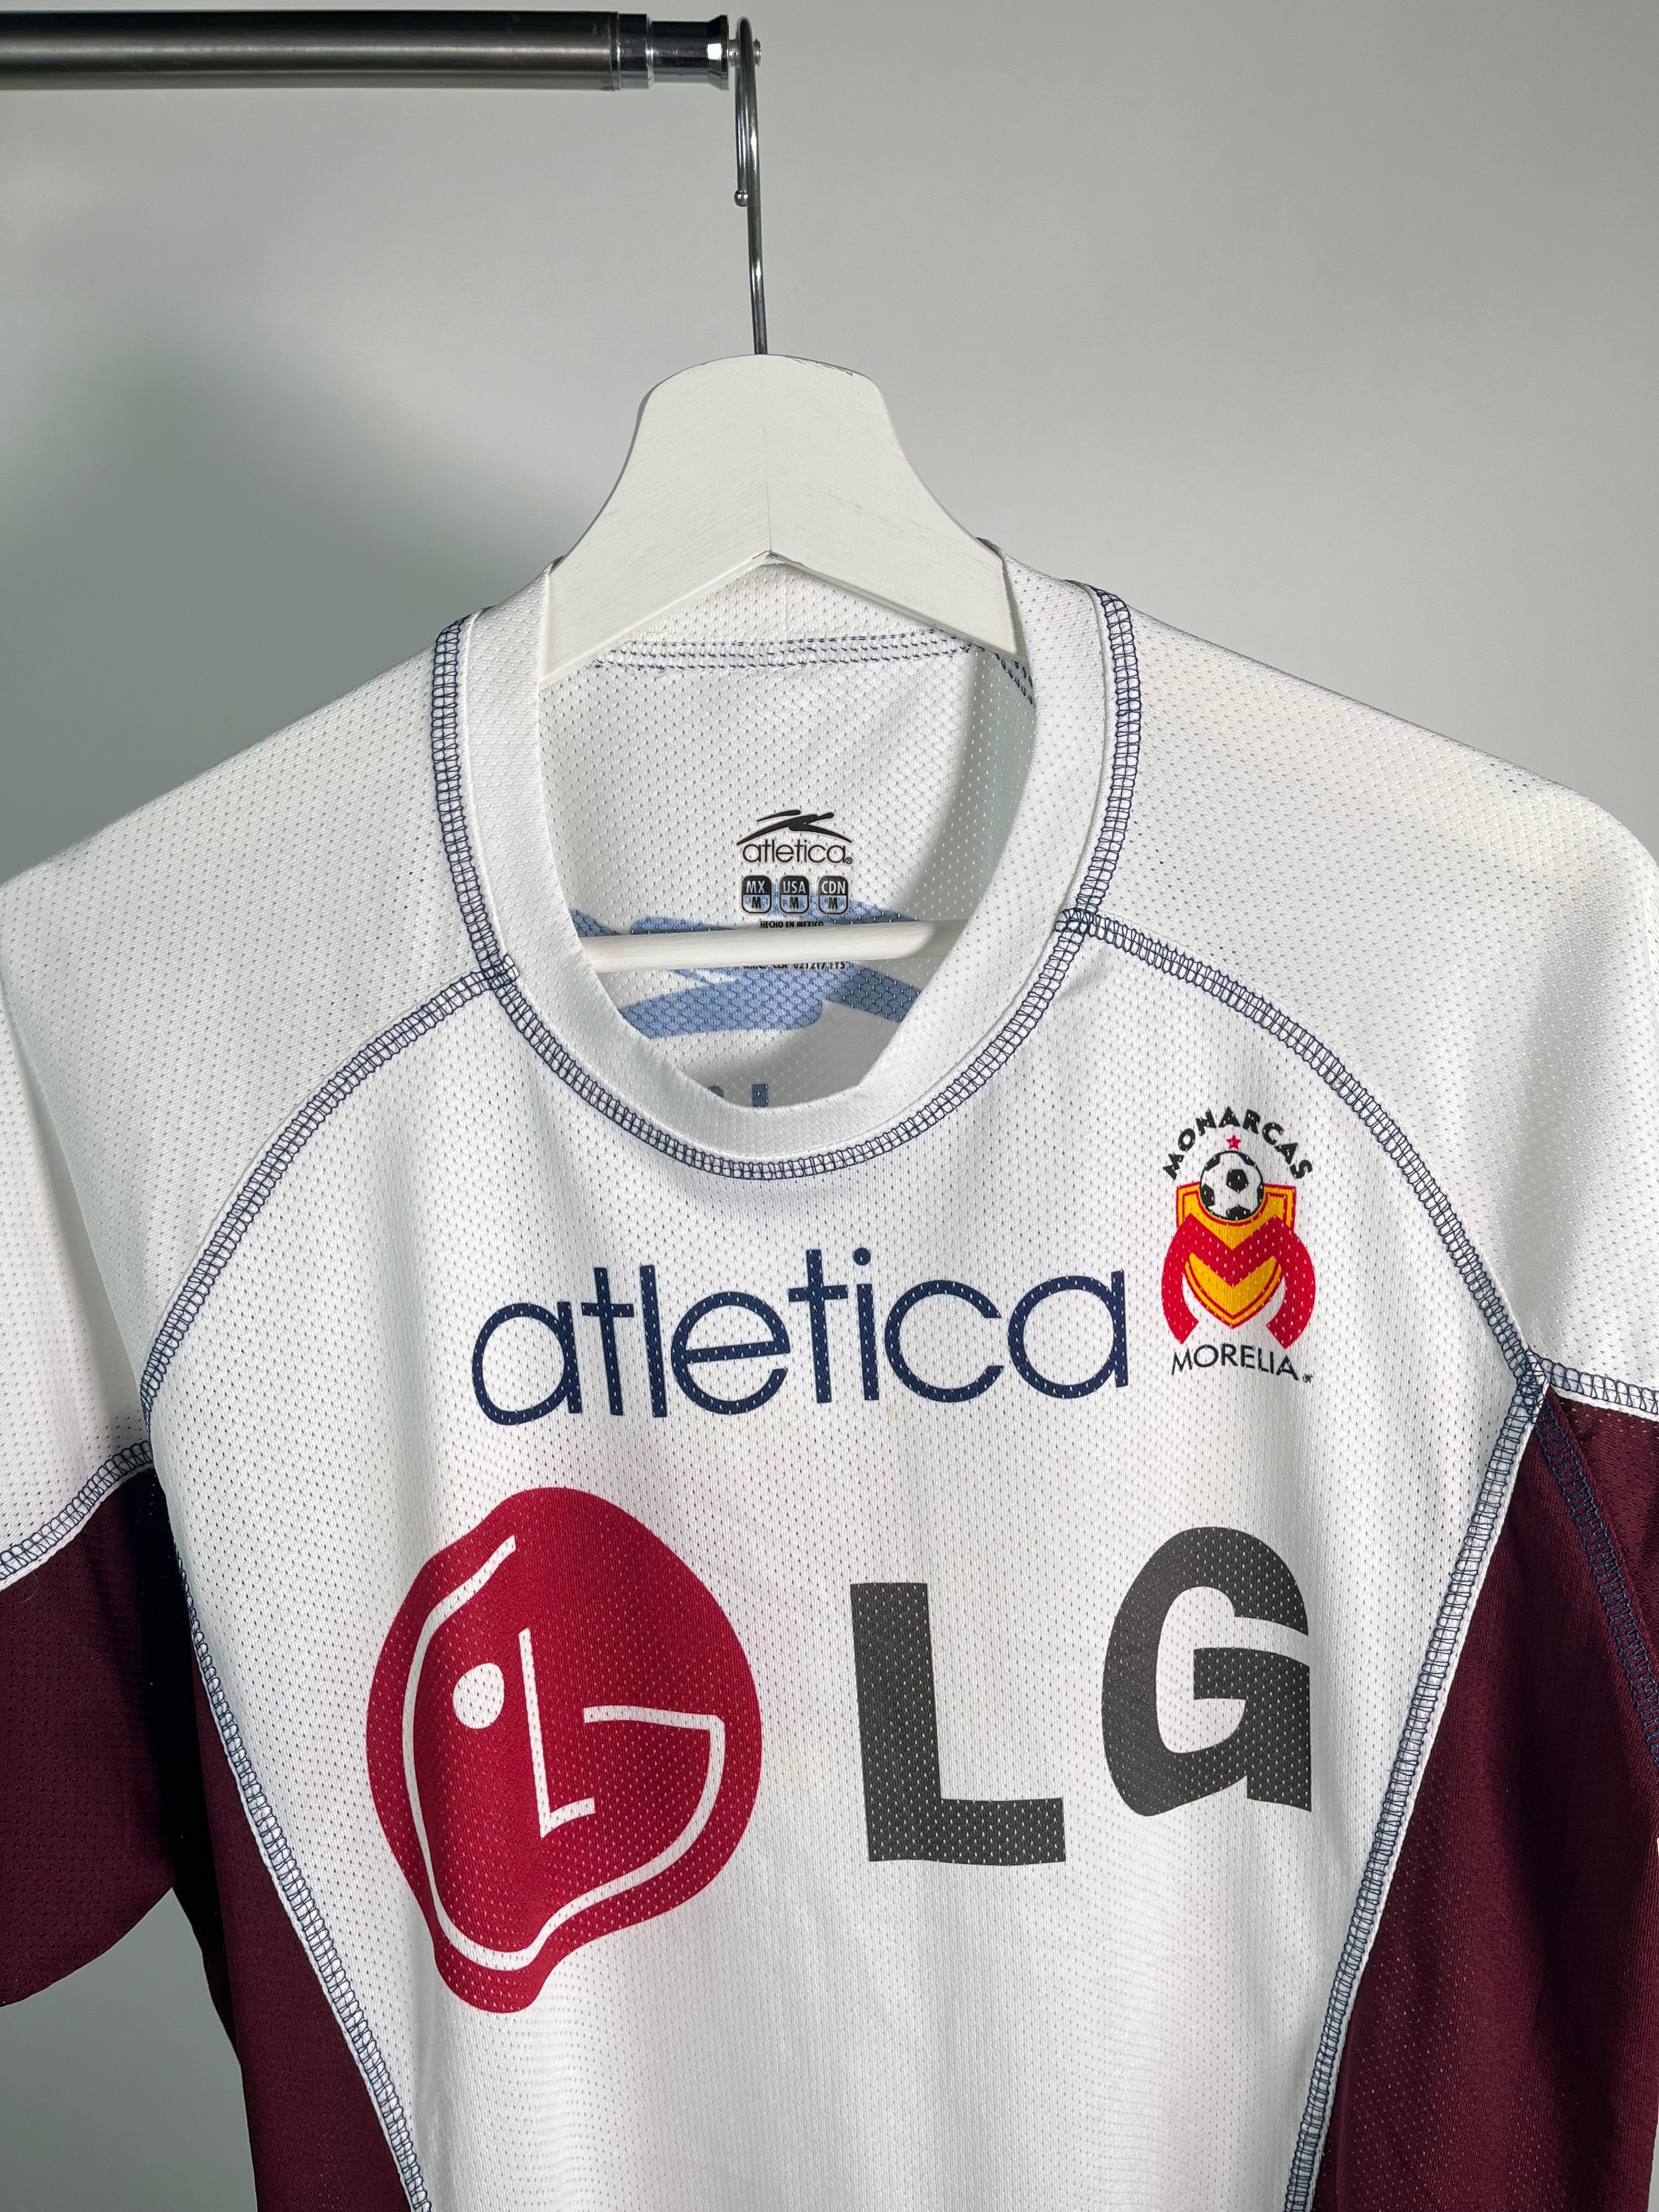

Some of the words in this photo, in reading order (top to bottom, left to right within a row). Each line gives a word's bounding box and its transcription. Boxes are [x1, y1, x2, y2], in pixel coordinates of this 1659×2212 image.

[746, 880, 765, 893] MX
[783, 881, 806, 893] USA
[821, 881, 845, 894] CDN
[752, 896, 761, 909] M
[789, 896, 799, 909] M
[828, 897, 838, 910] M
[1163, 1106, 1313, 1180] MONARCAS
[472, 1247, 1128, 1425] atletica
[1171, 1342, 1299, 1381] MORELIA
[849, 1526, 1312, 1866] LG
